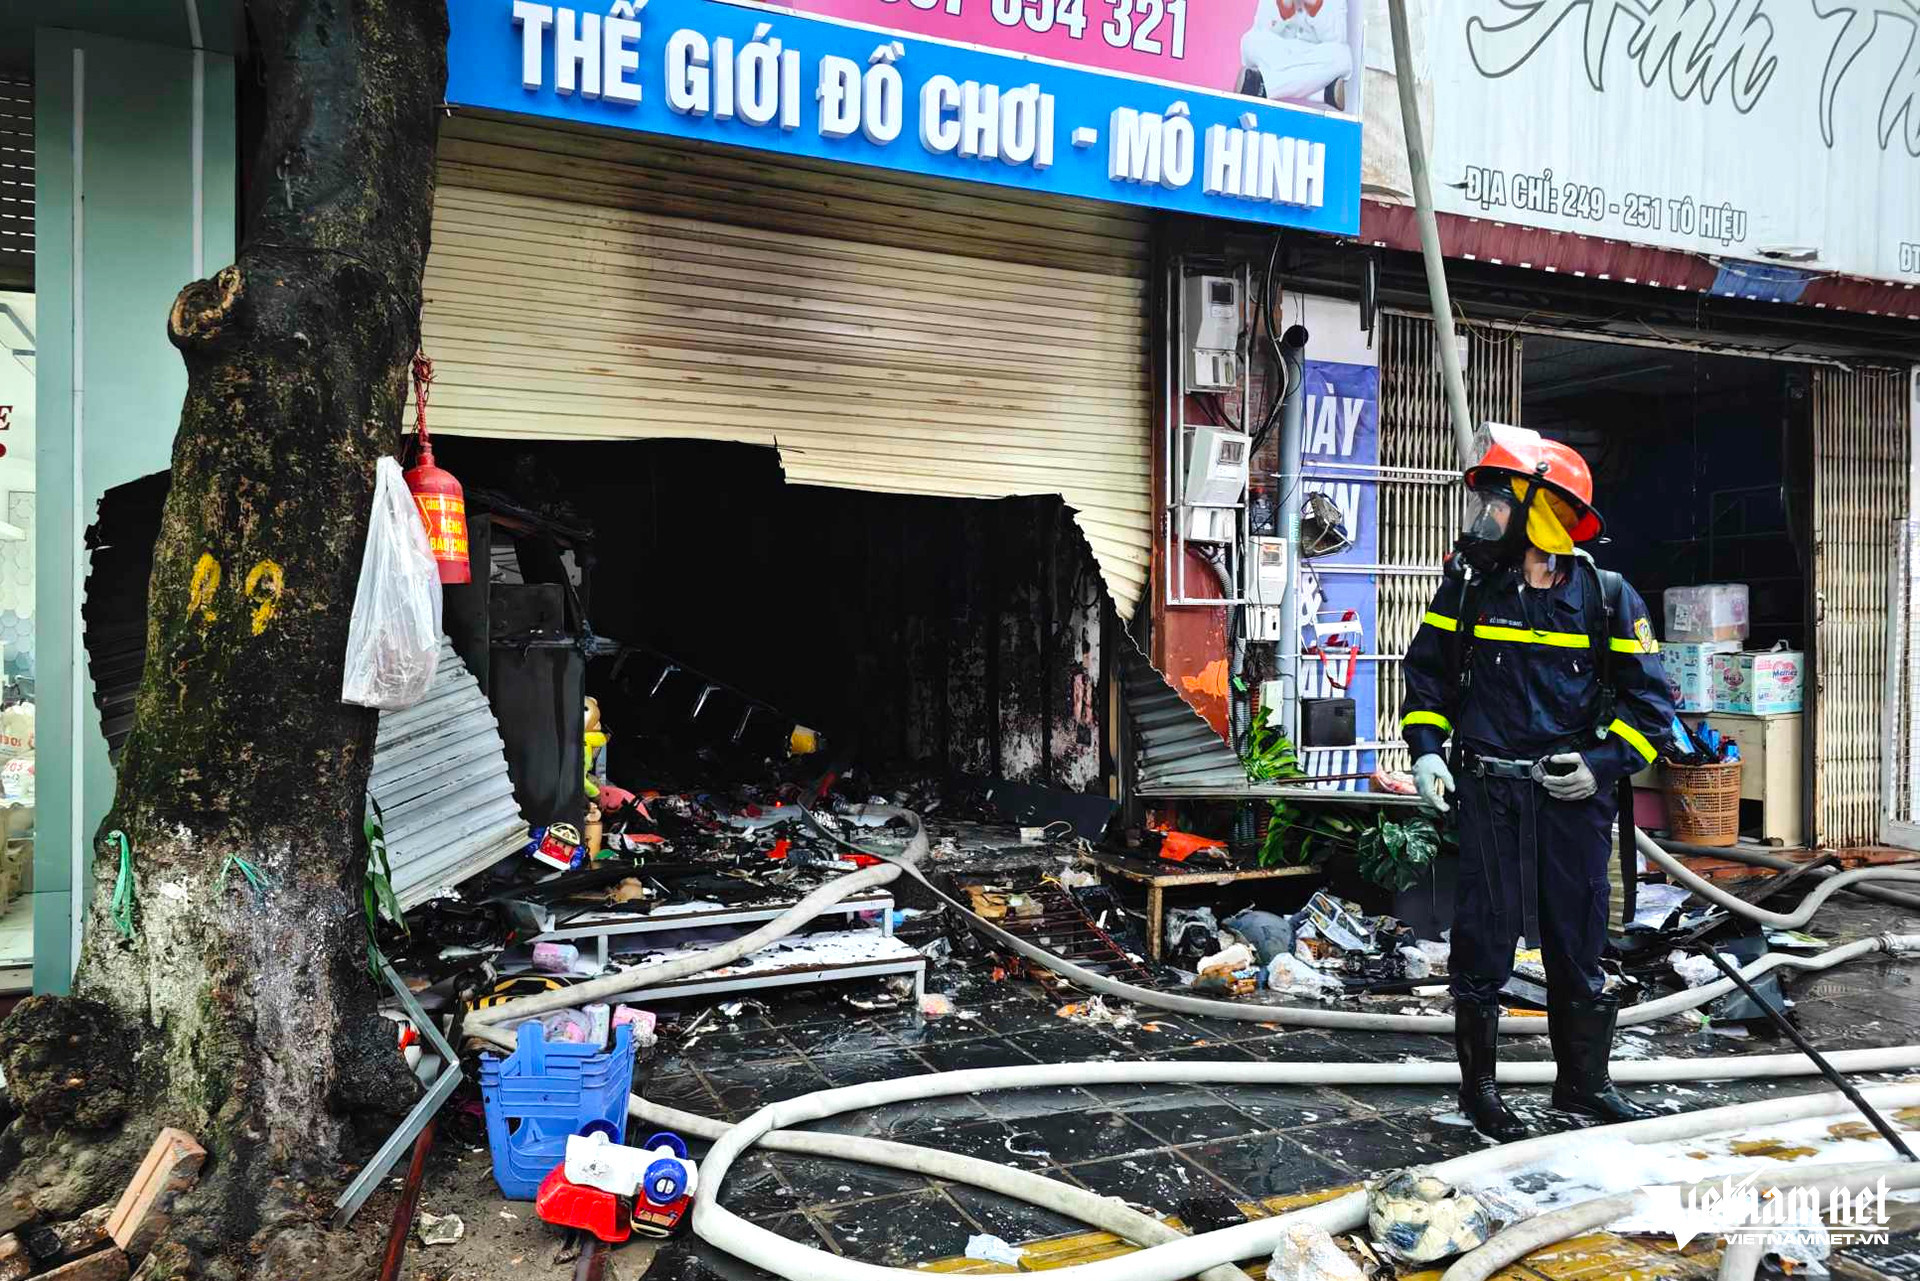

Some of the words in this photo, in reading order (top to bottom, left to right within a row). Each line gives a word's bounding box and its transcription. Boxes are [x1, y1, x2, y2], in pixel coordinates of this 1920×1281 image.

[513, 0, 648, 106] THẾ
[665, 23, 800, 132] GIỚI
[816, 41, 905, 146] ĐỒ
[920, 74, 1054, 170] CHƠI
[1108, 101, 1194, 190] MÔ
[1203, 112, 1325, 210] HÌNH
[1464, 165, 1506, 210] ĐỊA
[1512, 168, 1558, 213] CHỈ:
[1563, 183, 1604, 220] 249
[1624, 193, 1662, 230] 251
[1669, 196, 1695, 235] TÔ
[1700, 202, 1746, 246] HIỆU
